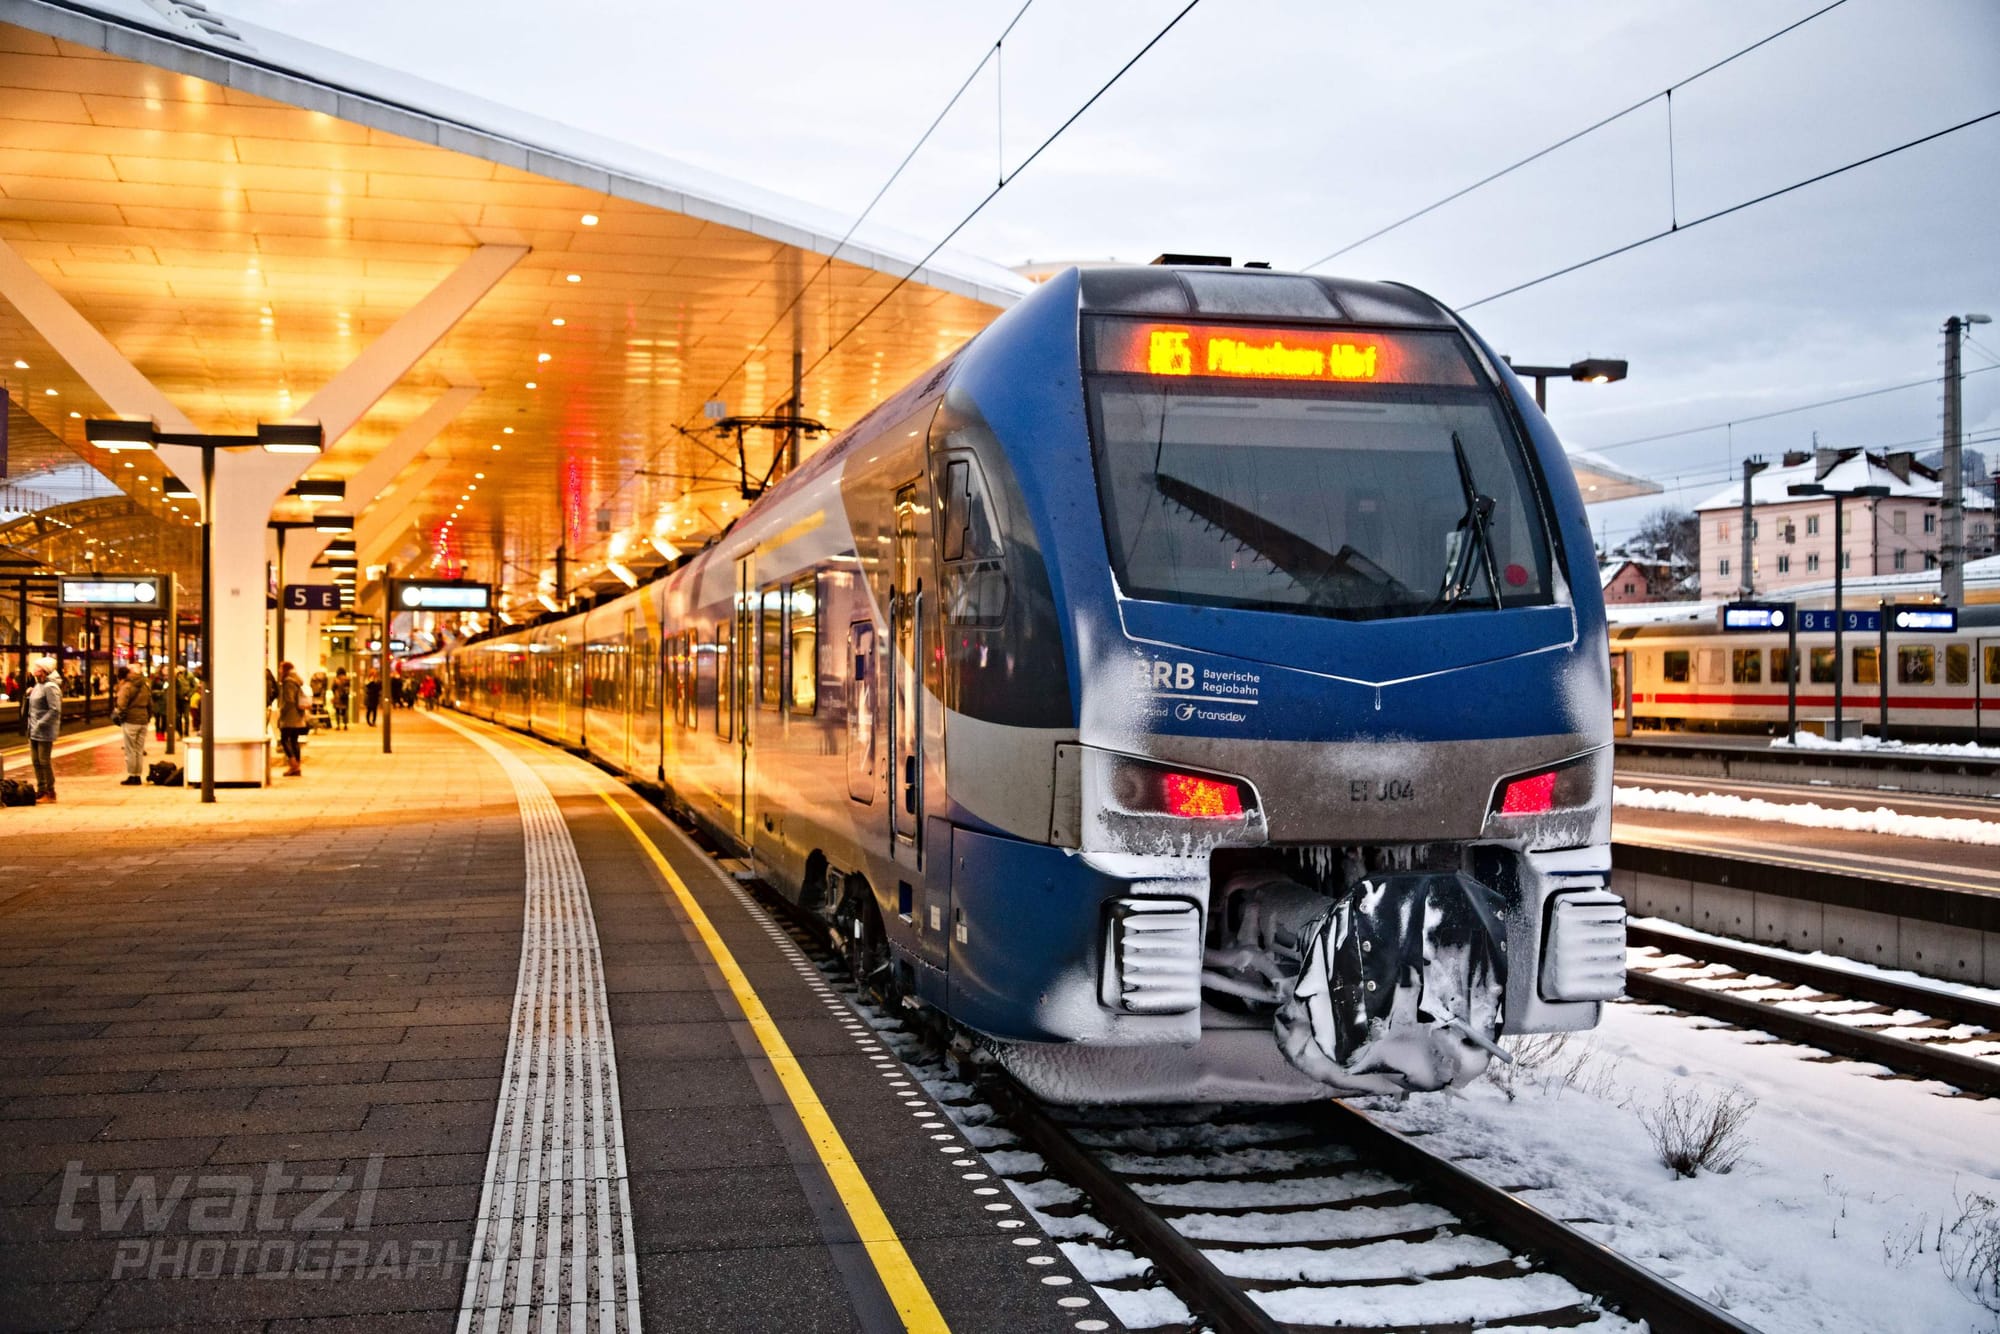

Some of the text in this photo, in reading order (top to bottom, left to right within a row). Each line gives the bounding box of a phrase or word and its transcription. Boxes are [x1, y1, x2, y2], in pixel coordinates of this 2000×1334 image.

[294, 588, 332, 607] 5 E
[1804, 613, 1831, 628] 8 E
[1849, 613, 1875, 629] 9 E
[1203, 669, 1260, 683] Bayerische
[1202, 682, 1259, 696] Regiobahn
[1197, 710, 1247, 723] transdev
